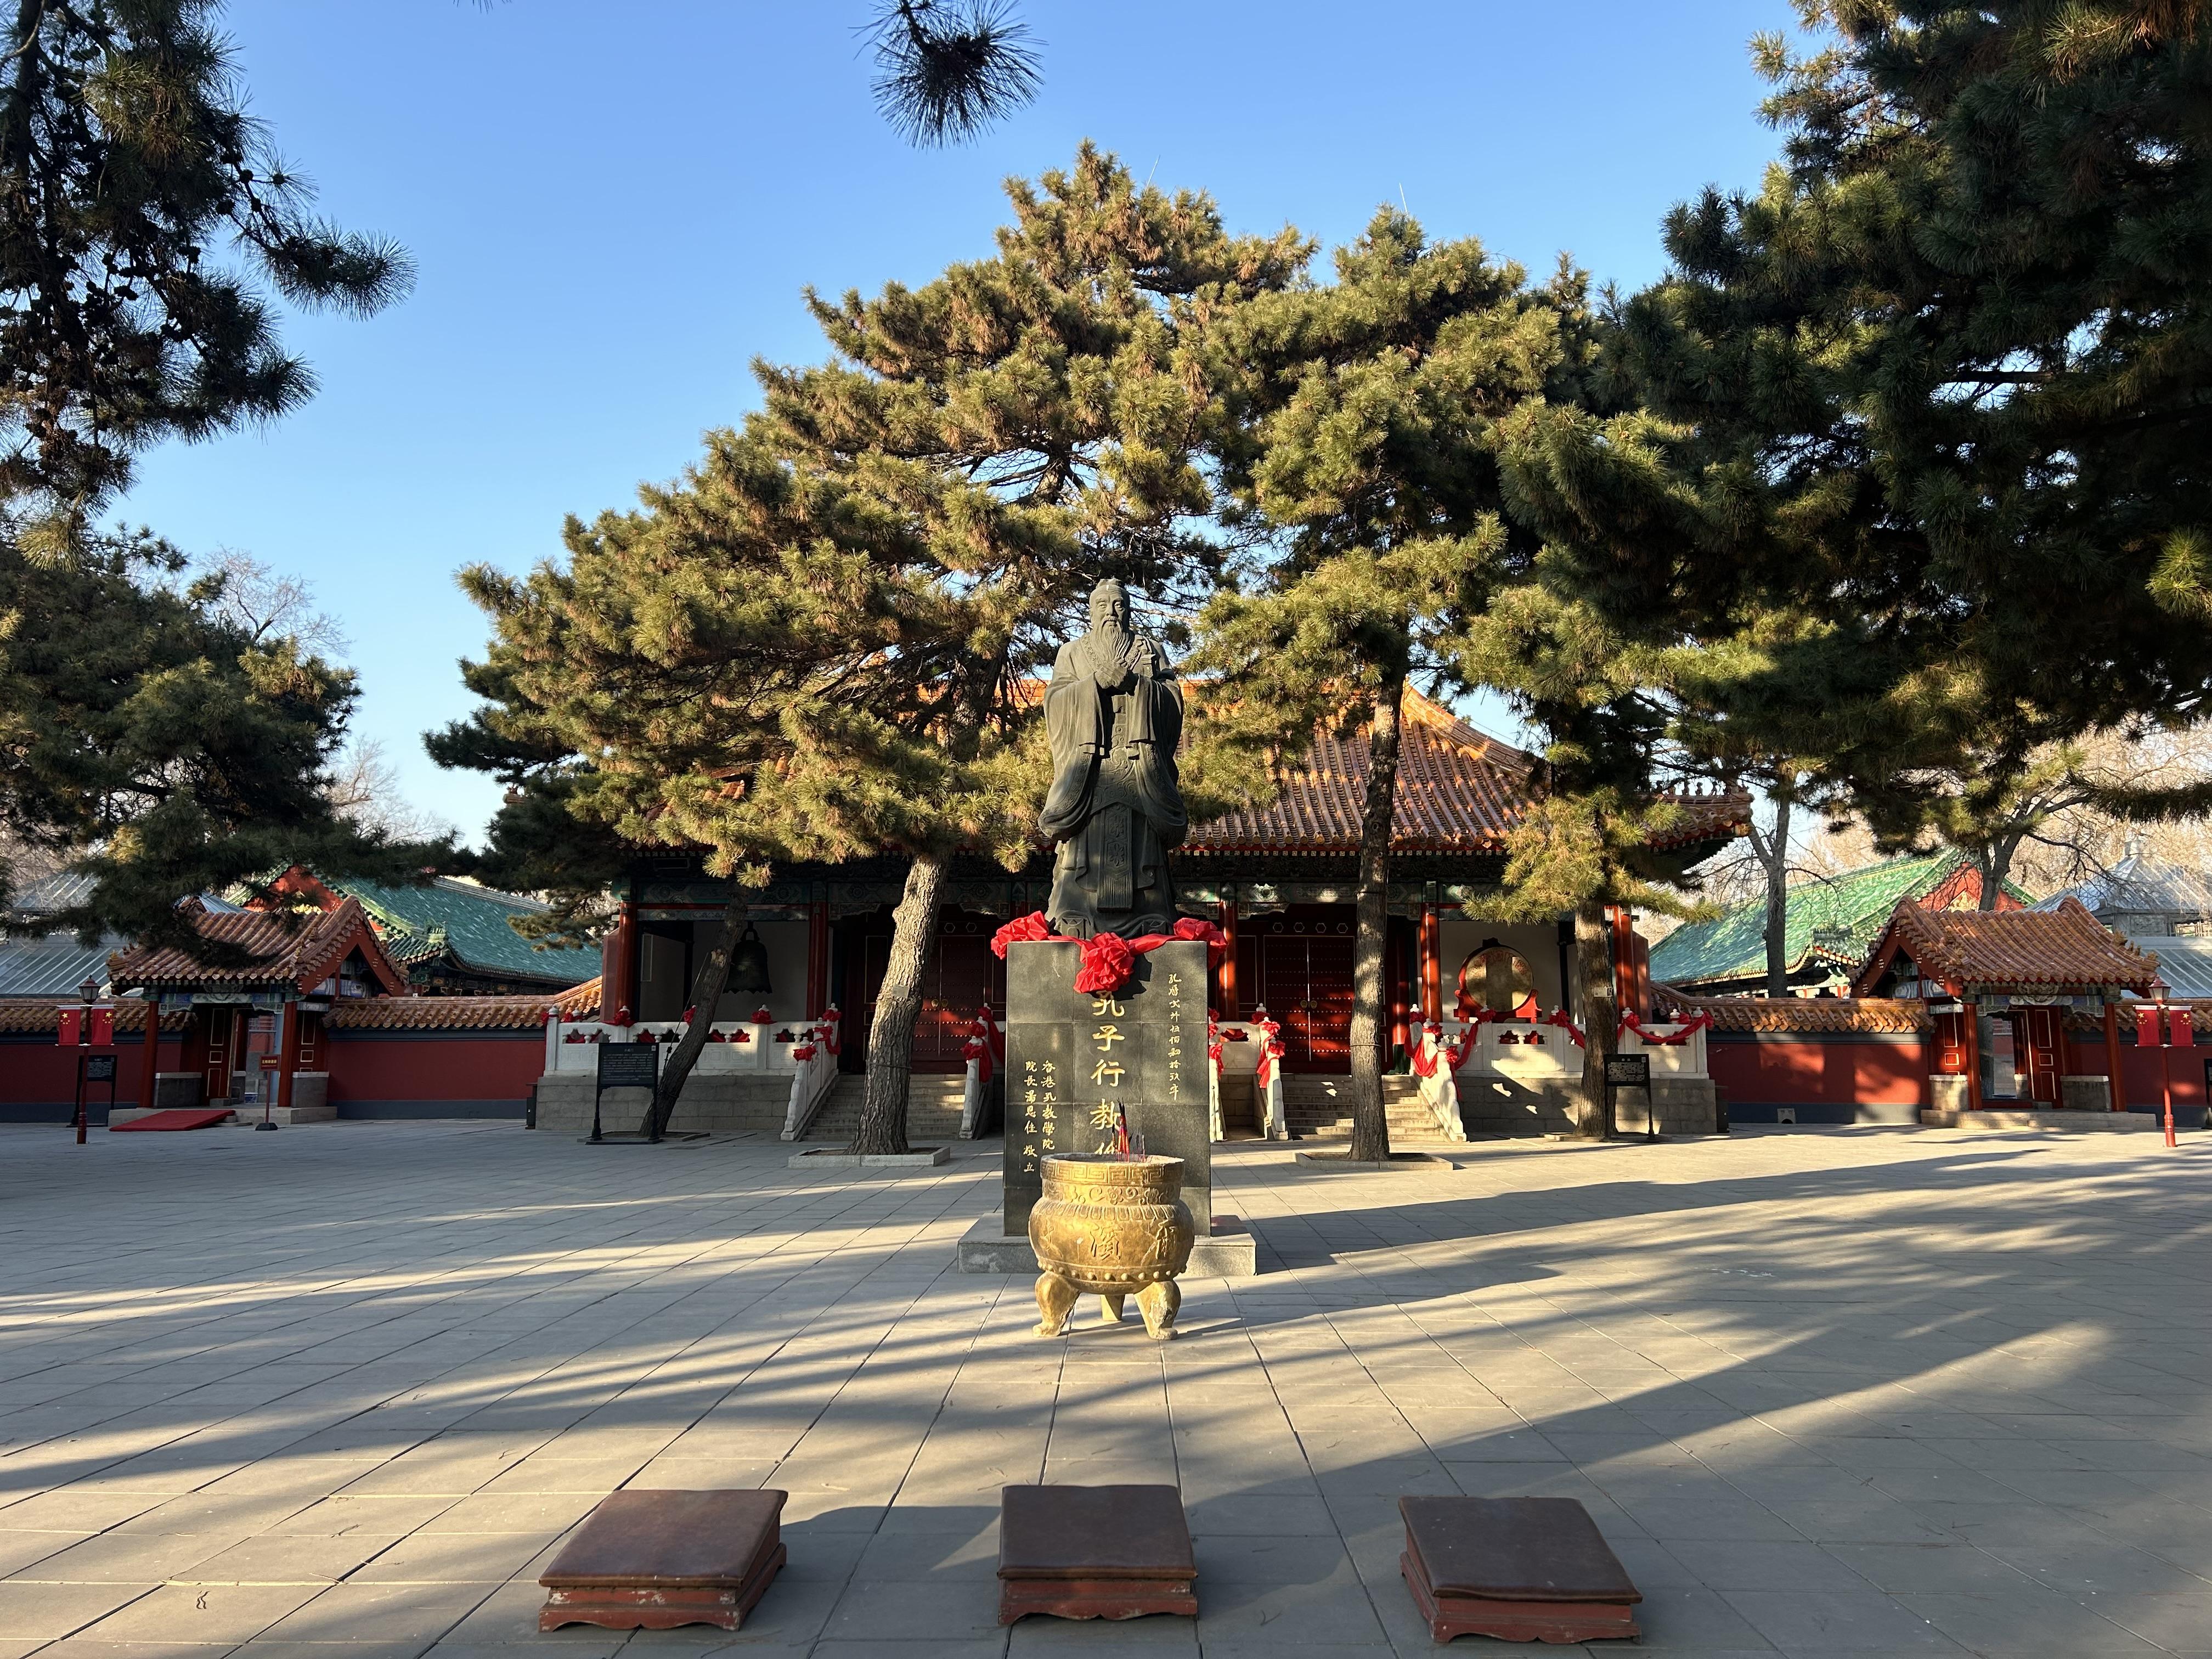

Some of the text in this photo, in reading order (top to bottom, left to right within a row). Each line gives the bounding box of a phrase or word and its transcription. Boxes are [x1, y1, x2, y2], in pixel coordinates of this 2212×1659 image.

[1041, 1059, 1057, 1150] 香港孔教學院
